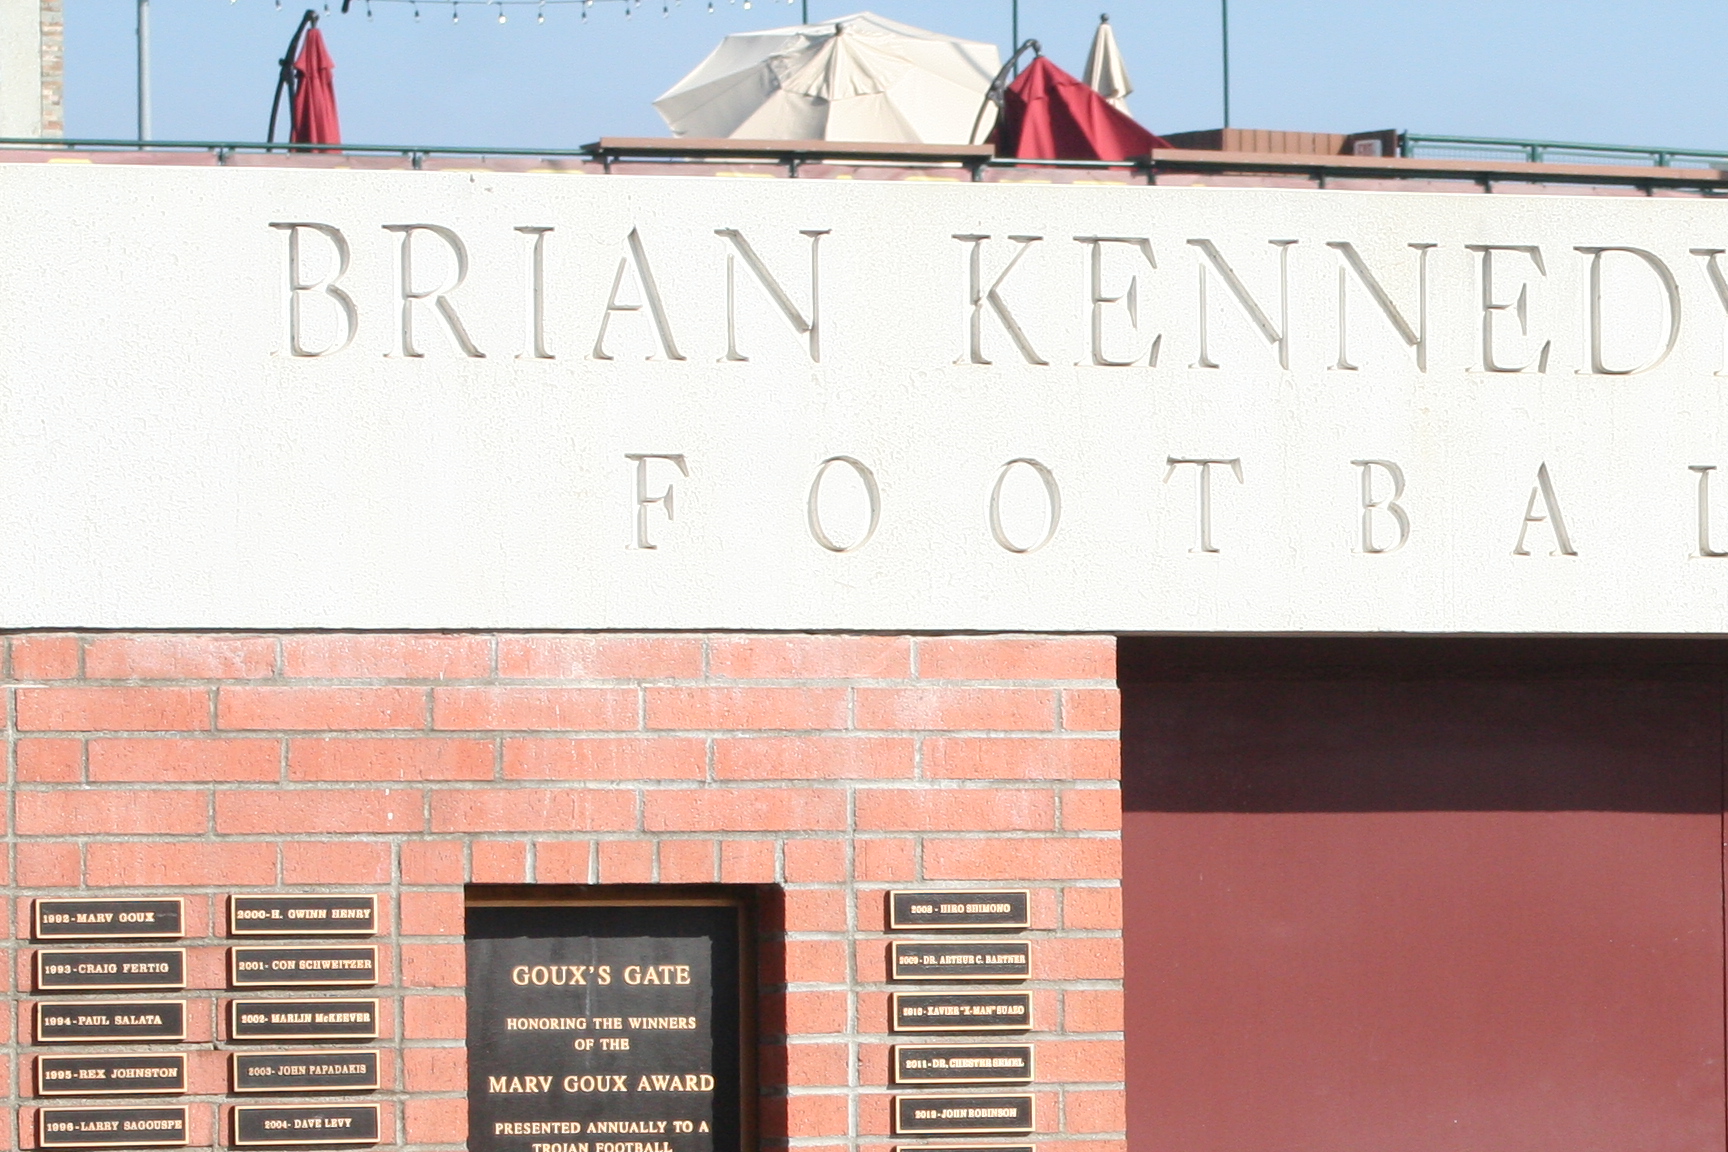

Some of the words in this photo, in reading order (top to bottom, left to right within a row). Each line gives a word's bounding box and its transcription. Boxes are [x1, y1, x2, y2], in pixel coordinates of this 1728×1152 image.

[268, 221, 832, 364] BRIAN
[44, 913, 113, 923] 1992-MARV
[119, 913, 154, 922] GOUX
[288, 910, 327, 918] GWINN
[332, 909, 371, 918] HENRY
[272, 961, 295, 970] CON
[299, 960, 371, 969] SCHWEITZER
[976, 955, 983, 964] C.
[45, 964, 117, 974] 1993-CRAIG
[123, 963, 168, 972] FERTIG
[513, 966, 610, 985] GOUX'S
[624, 966, 690, 984] GATE
[45, 1016, 109, 1025] 1994-PAUL
[115, 1015, 162, 1024] SALATA
[272, 1014, 311, 1023] MARLIN
[316, 1013, 370, 1022] McKEEVER
[507, 1018, 586, 1030] HONORING
[593, 1018, 622, 1029] THE
[628, 1017, 695, 1029] WINNERS
[575, 1039, 594, 1050] OF
[600, 1039, 629, 1050] THE
[46, 1070, 106, 1079] 1995-REX
[111, 1068, 177, 1078] JOHNSTON
[278, 1066, 306, 1075] JOHN
[310, 1065, 366, 1074] PAPADAKIS
[489, 1076, 552, 1092] MARV
[564, 1076, 627, 1092] GOUX
[637, 1075, 714, 1091] AWARD
[47, 1121, 119, 1131] 1996-LARRY
[124, 1120, 182, 1130] SAGOUSPE
[294, 1119, 322, 1128] DAVE
[325, 1119, 351, 1127] LEVY
[496, 1123, 580, 1134] PRESENTED
[587, 1121, 667, 1133] ANNUALLY
[673, 1121, 693, 1132] TO
[699, 1121, 709, 1132] A
